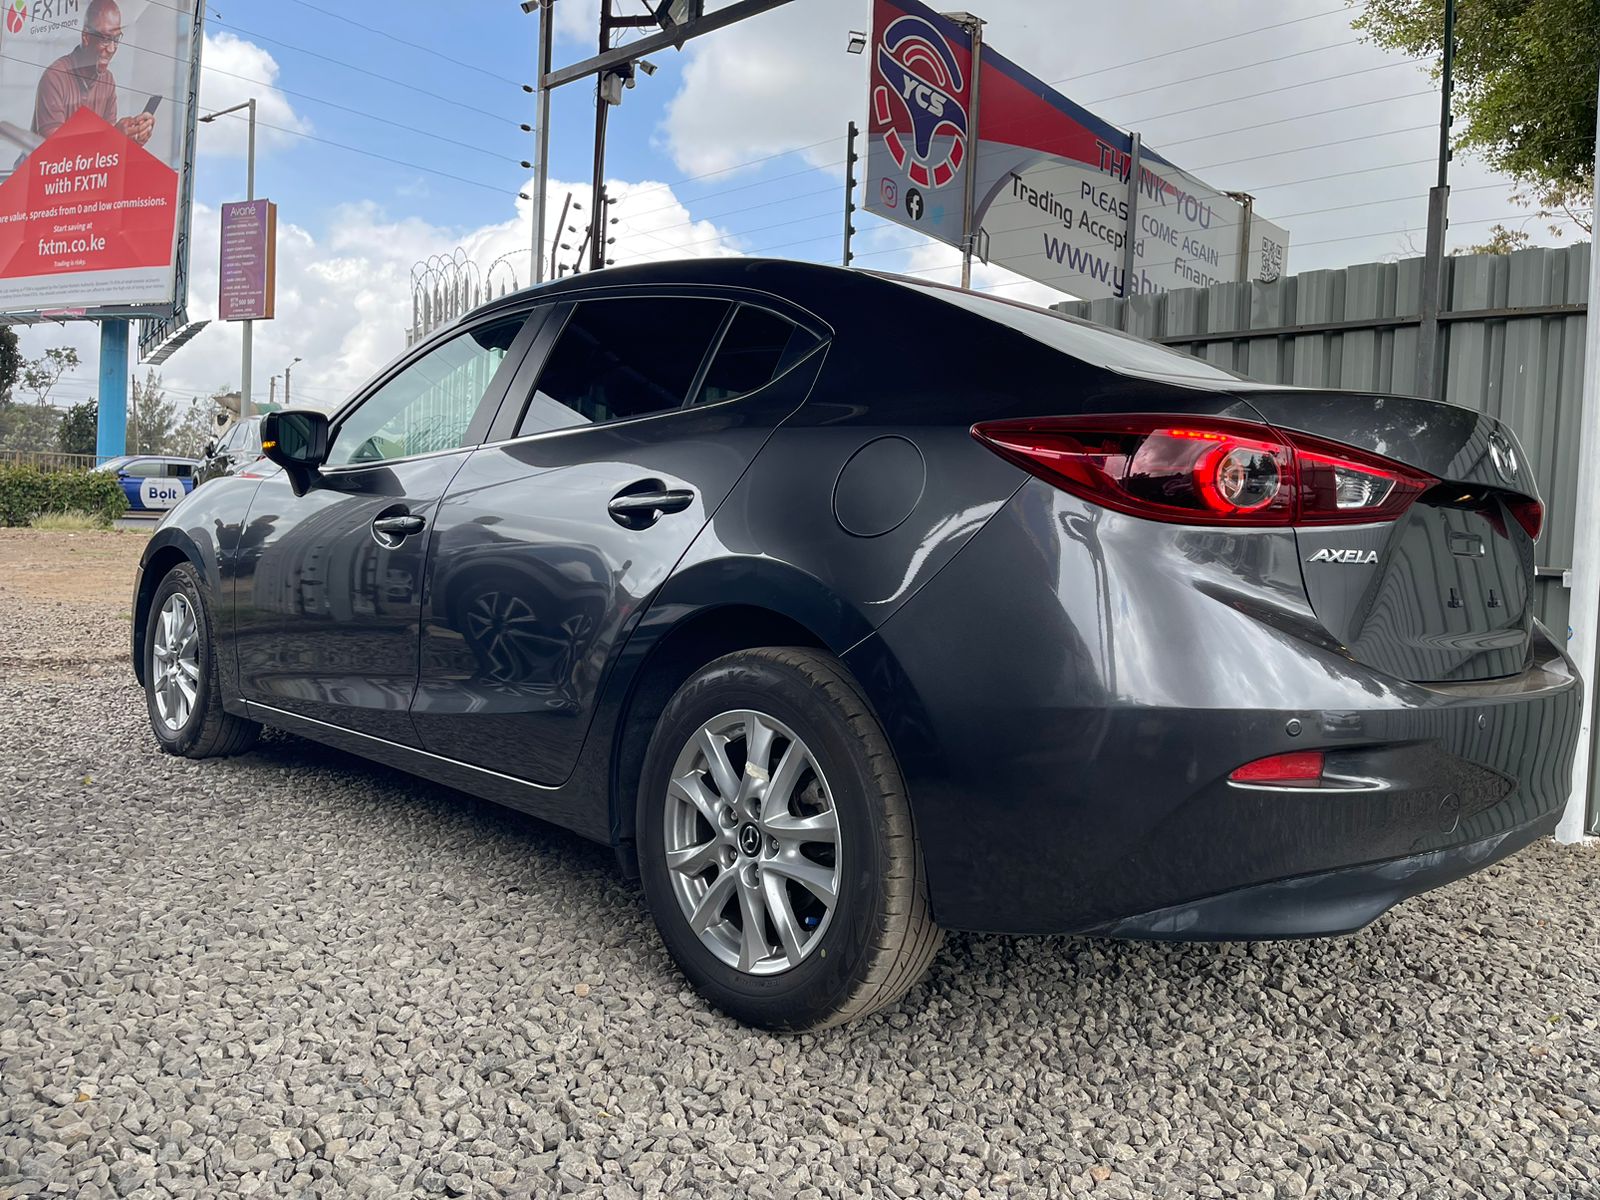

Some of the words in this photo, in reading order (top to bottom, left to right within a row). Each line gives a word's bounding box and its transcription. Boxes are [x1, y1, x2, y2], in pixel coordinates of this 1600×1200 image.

[30, 25, 47, 35] Gives
[48, 22, 60, 33] you
[61, 19, 79, 28] more
[901, 74, 949, 118] YCS
[40, 157, 72, 176] Trade
[75, 154, 94, 171] for
[95, 152, 118, 168] less
[44, 178, 71, 195] with
[74, 173, 108, 192] FXTM
[10, 211, 28, 223] value,
[30, 206, 58, 221] spreads
[58, 204, 76, 216] from
[78, 204, 82, 214] 0
[84, 202, 98, 213] and
[98, 200, 112, 211] low
[113, 197, 167, 210] commissions.
[230, 204, 256, 216] Avané
[1010, 172, 1073, 230] Trading
[1078, 210, 1144, 258] Acceptd
[1174, 186, 1211, 229] YOU
[53, 224, 67, 233] Start
[68, 223, 86, 233] saving
[86, 221, 93, 230] at
[1081, 180, 1129, 221] PLEAS
[1142, 214, 1178, 247] COME
[1182, 236, 1219, 267] AGAIN
[38, 234, 106, 256] fxtm.co.ke
[148, 487, 177, 500] Bolt
[1307, 548, 1379, 564] AXELA
